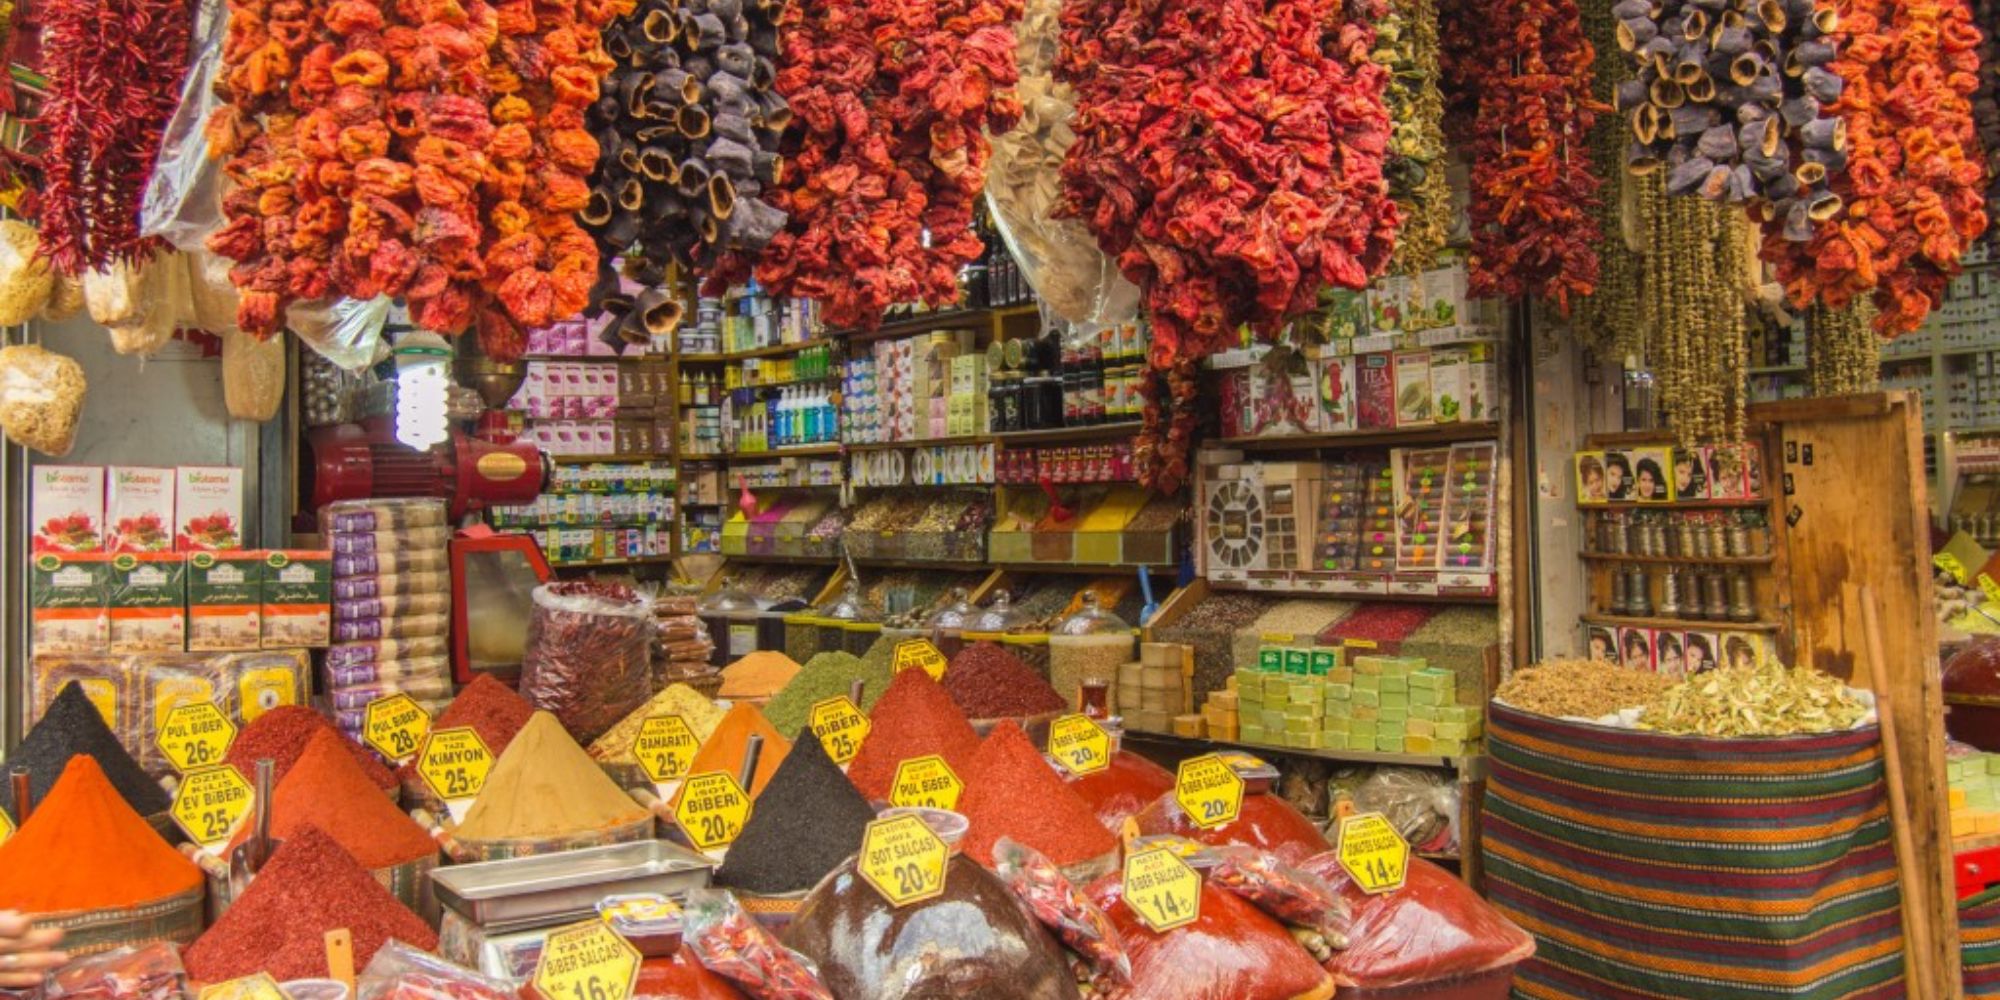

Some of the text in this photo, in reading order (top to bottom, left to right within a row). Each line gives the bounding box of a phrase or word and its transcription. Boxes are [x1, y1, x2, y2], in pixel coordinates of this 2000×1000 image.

[1363, 369, 1388, 384] TEA
[167, 726, 189, 739] PUL
[640, 734, 690, 750] BAHARATI
[900, 783, 921, 797] PUL
[183, 795, 199, 810] EV
[556, 936, 605, 954] TATLI
